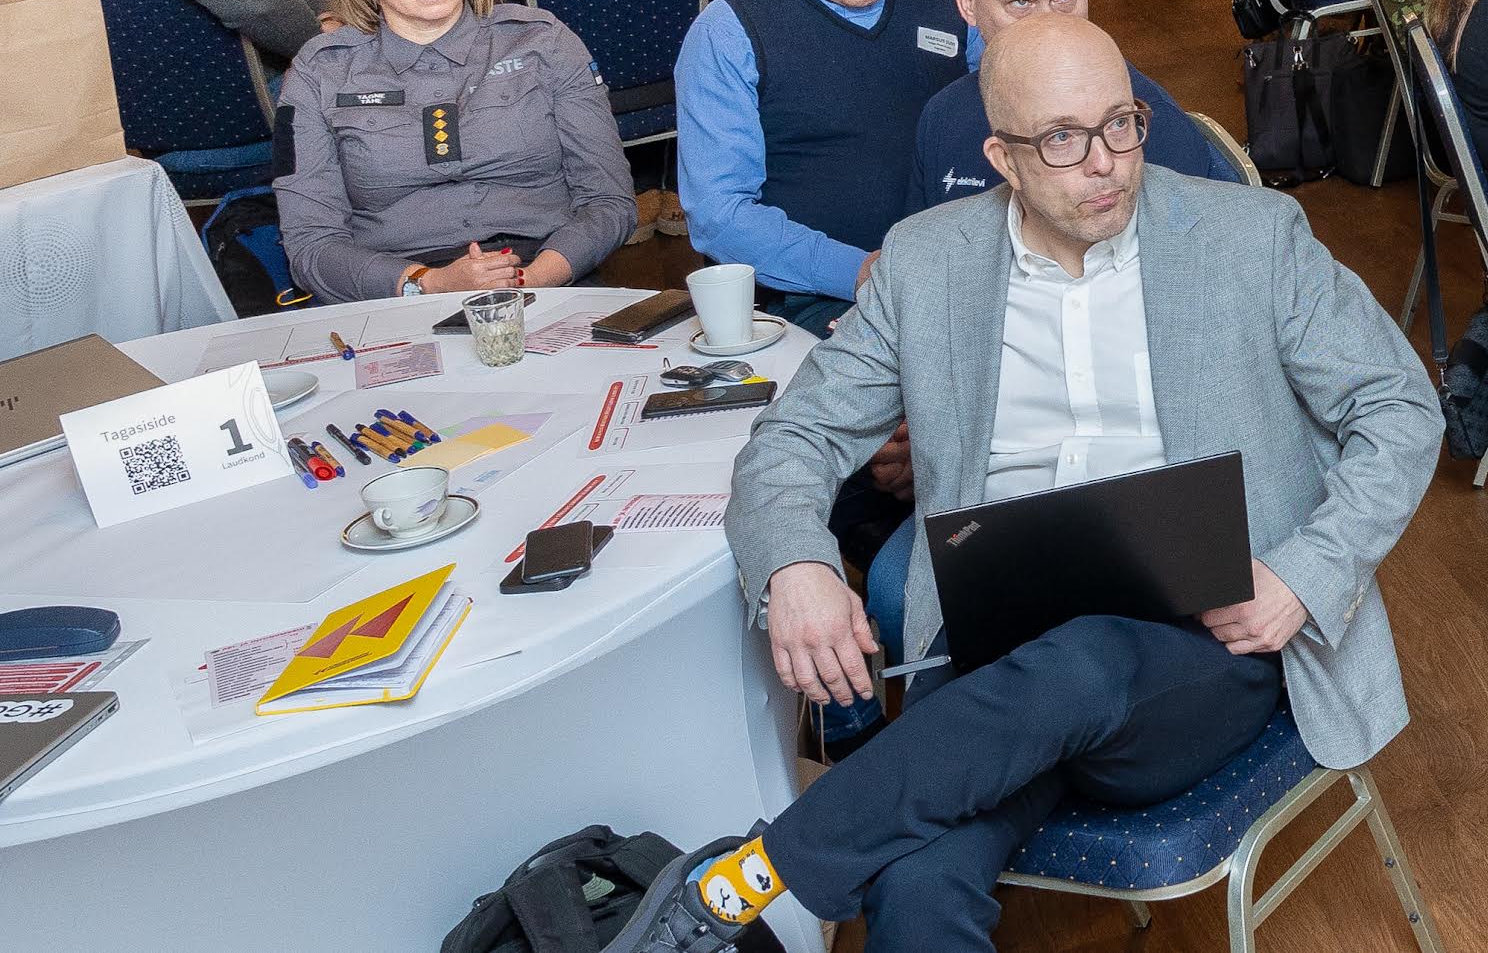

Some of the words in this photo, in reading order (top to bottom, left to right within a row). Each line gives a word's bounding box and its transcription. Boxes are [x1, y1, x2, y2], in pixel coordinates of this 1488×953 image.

[100, 414, 176, 443] Tagasiside
[219, 417, 253, 456] 1
[221, 450, 266, 470] Laudkond
